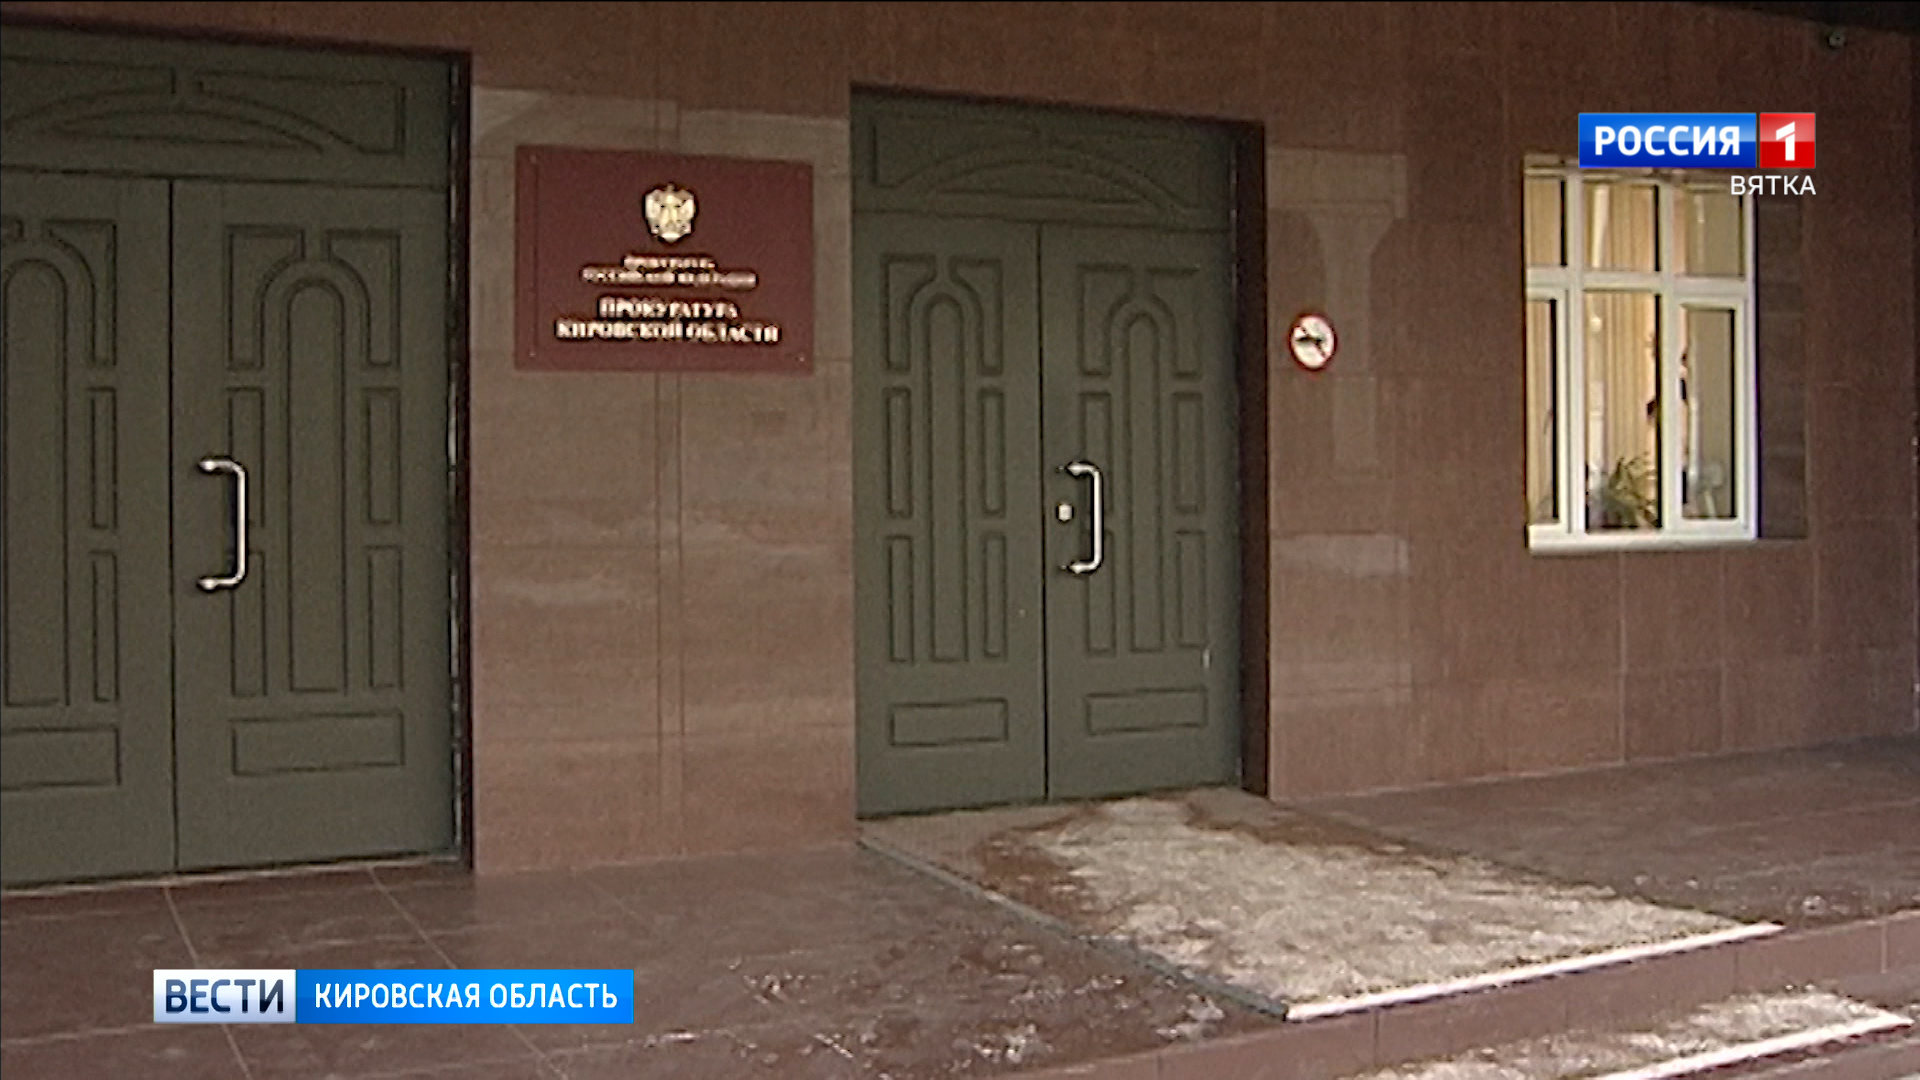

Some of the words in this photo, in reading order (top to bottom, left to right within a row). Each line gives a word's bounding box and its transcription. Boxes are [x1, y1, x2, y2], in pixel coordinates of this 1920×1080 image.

[600, 297, 738, 319] ПРОКУРАТУРА
[556, 320, 683, 339] КИРОВСКОЙ
[686, 323, 780, 343] ОБЛАСТИ
